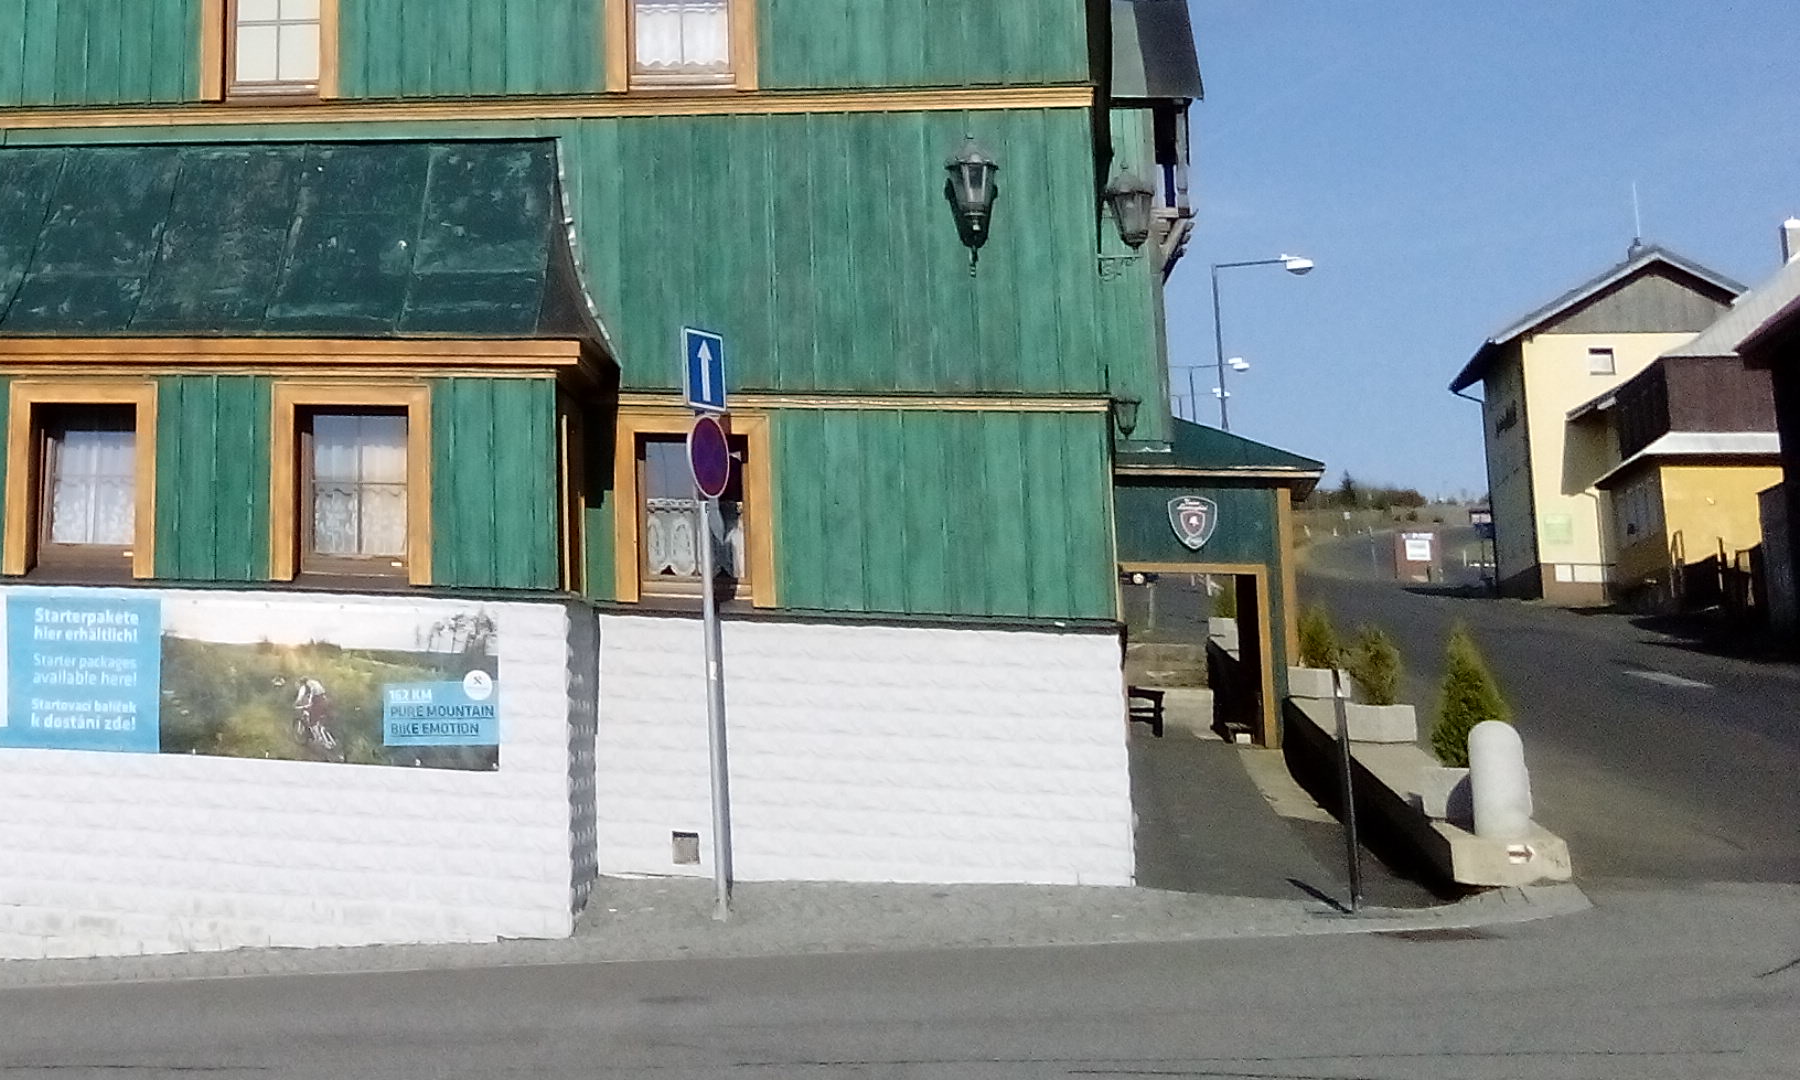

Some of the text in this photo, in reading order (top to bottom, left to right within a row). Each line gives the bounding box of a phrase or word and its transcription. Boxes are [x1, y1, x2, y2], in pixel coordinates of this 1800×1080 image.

[34, 607, 139, 626] Starterpakete
[34, 625, 138, 642] hier erhältlich!
[33, 653, 137, 672] Starter packages
[32, 669, 137, 687] available here!
[411, 688, 432, 701] KM
[390, 705, 494, 717] PURE MOUNTAIN
[31, 712, 40, 728] k
[104, 716, 136, 730] zde!
[390, 723, 479, 735] BIKE EMOTION
